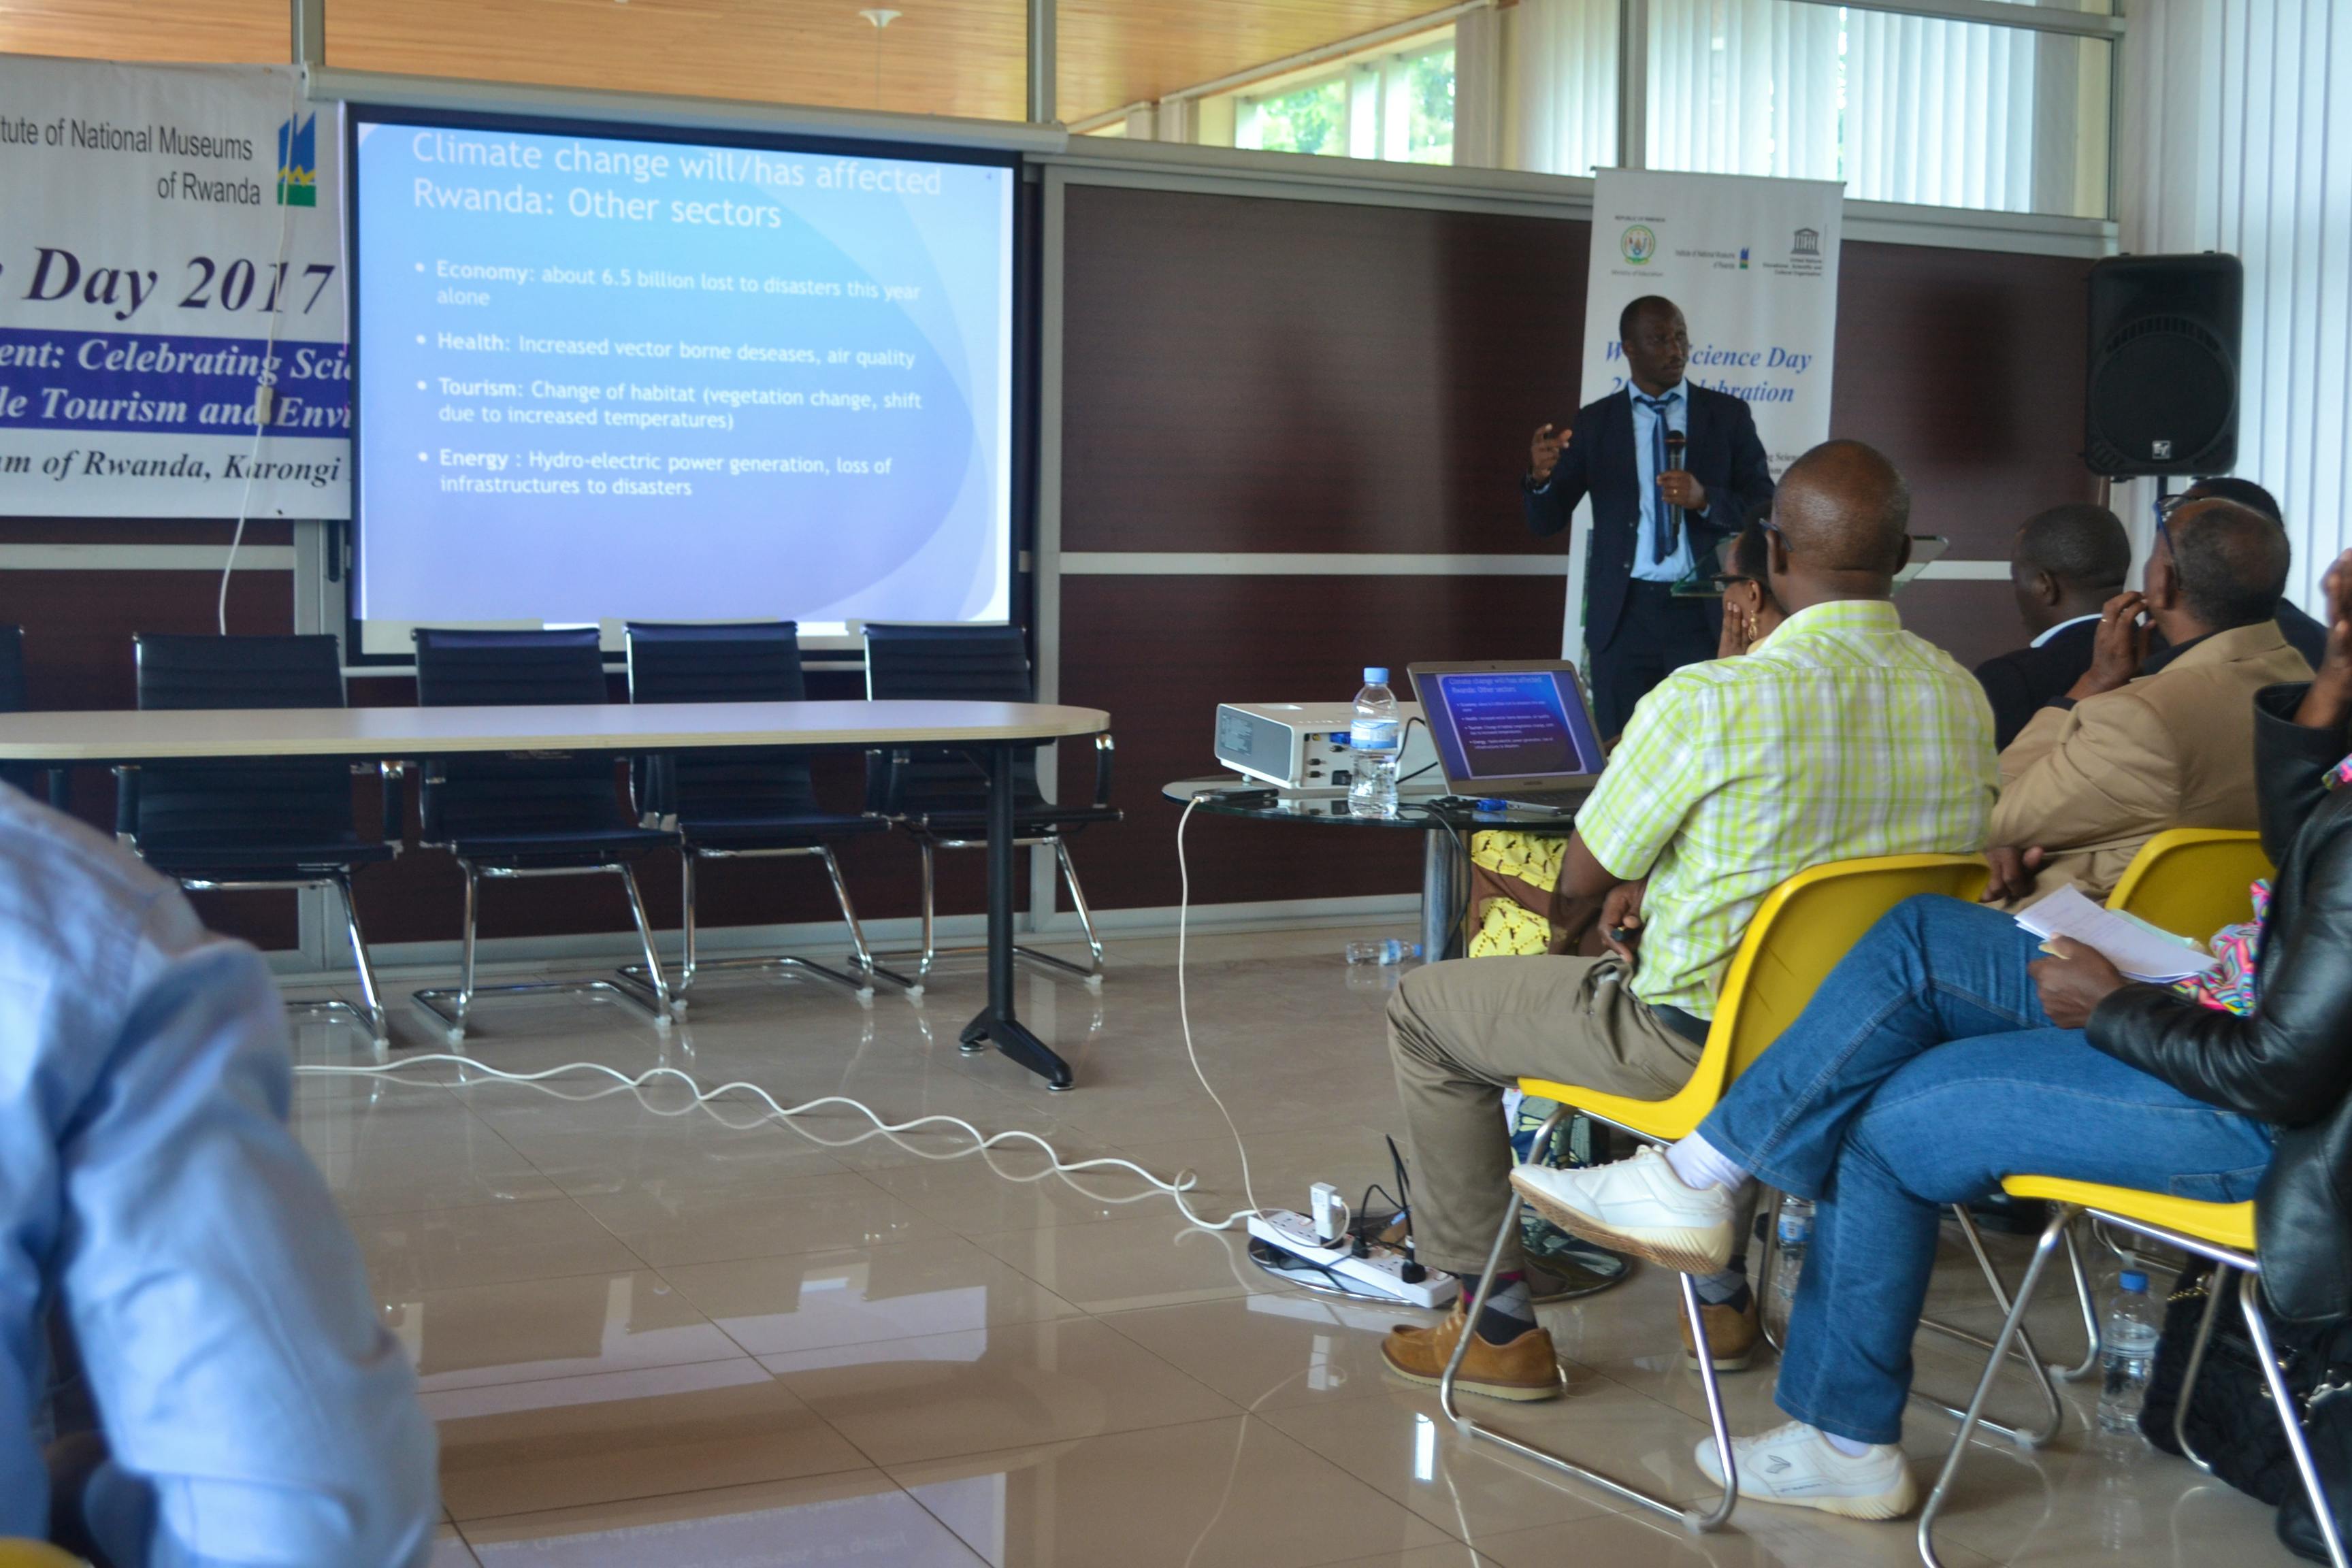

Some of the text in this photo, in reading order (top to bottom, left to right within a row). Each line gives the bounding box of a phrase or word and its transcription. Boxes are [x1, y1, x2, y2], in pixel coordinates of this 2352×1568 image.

[46, 117, 66, 146] of
[71, 120, 152, 153] National
[159, 127, 252, 161] Museums
[412, 132, 941, 195] Climate change will/has affected
[157, 171, 261, 205] of Rwanda
[414, 178, 782, 229] Rwanda: Other sectors
[21, 247, 336, 321] Day 2017
[436, 259, 921, 303] Economy: about 6.5 billion lost to disasters this year
[436, 286, 491, 307] alone
[78, 338, 282, 386] Celebrating
[438, 331, 915, 370] Health: Increased vector borne deseases, air quality
[1688, 343, 1812, 374] cience Day
[41, 387, 188, 424] Tourism
[438, 377, 923, 411] Tourism: Change of habitat (vegetation change, shift
[438, 404, 735, 431] due to increased temperatures)
[42, 449, 80, 481] of
[82, 450, 212, 483] Rwanda,
[222, 453, 341, 489] Karongi
[439, 448, 509, 472] Energy
[529, 450, 662, 472] Hydro-electric
[668, 457, 725, 474] power
[729, 455, 830, 476] generation,
[836, 457, 870, 474] loss
[874, 457, 894, 475] of
[441, 475, 693, 497] infrastructures to disasters
